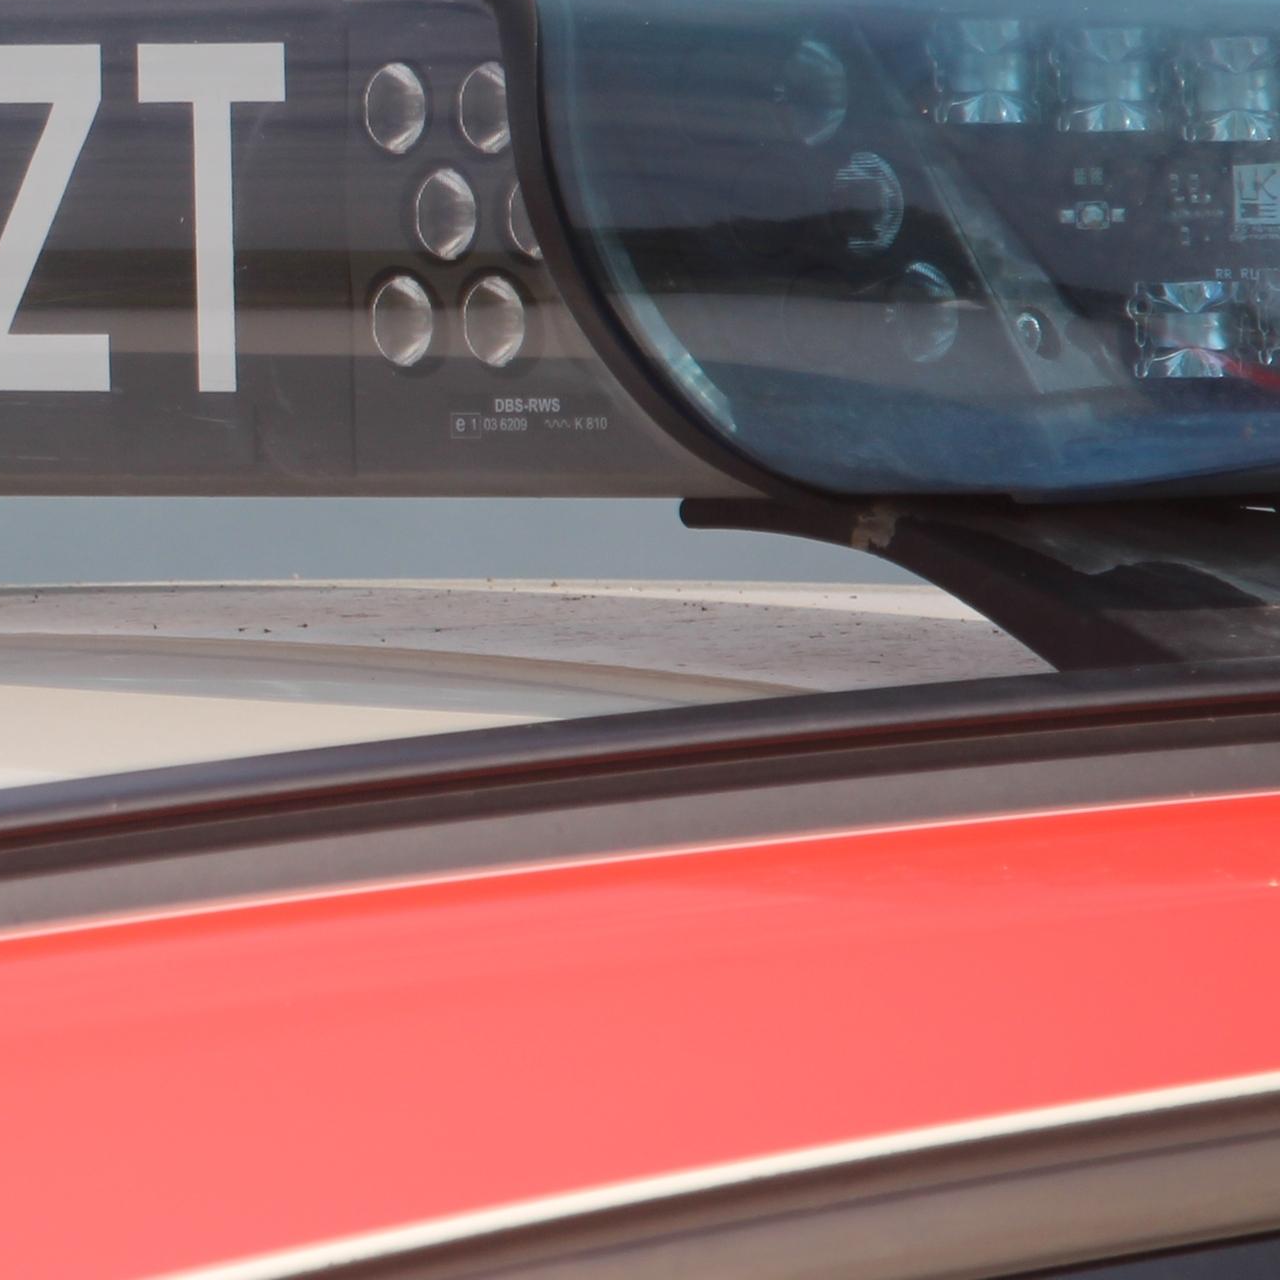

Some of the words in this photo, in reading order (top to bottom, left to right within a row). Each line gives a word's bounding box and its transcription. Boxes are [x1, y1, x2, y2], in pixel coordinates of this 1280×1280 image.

[494, 398, 561, 413] DBS-RWS
[483, 417, 498, 431] 03
[574, 417, 584, 430] K
